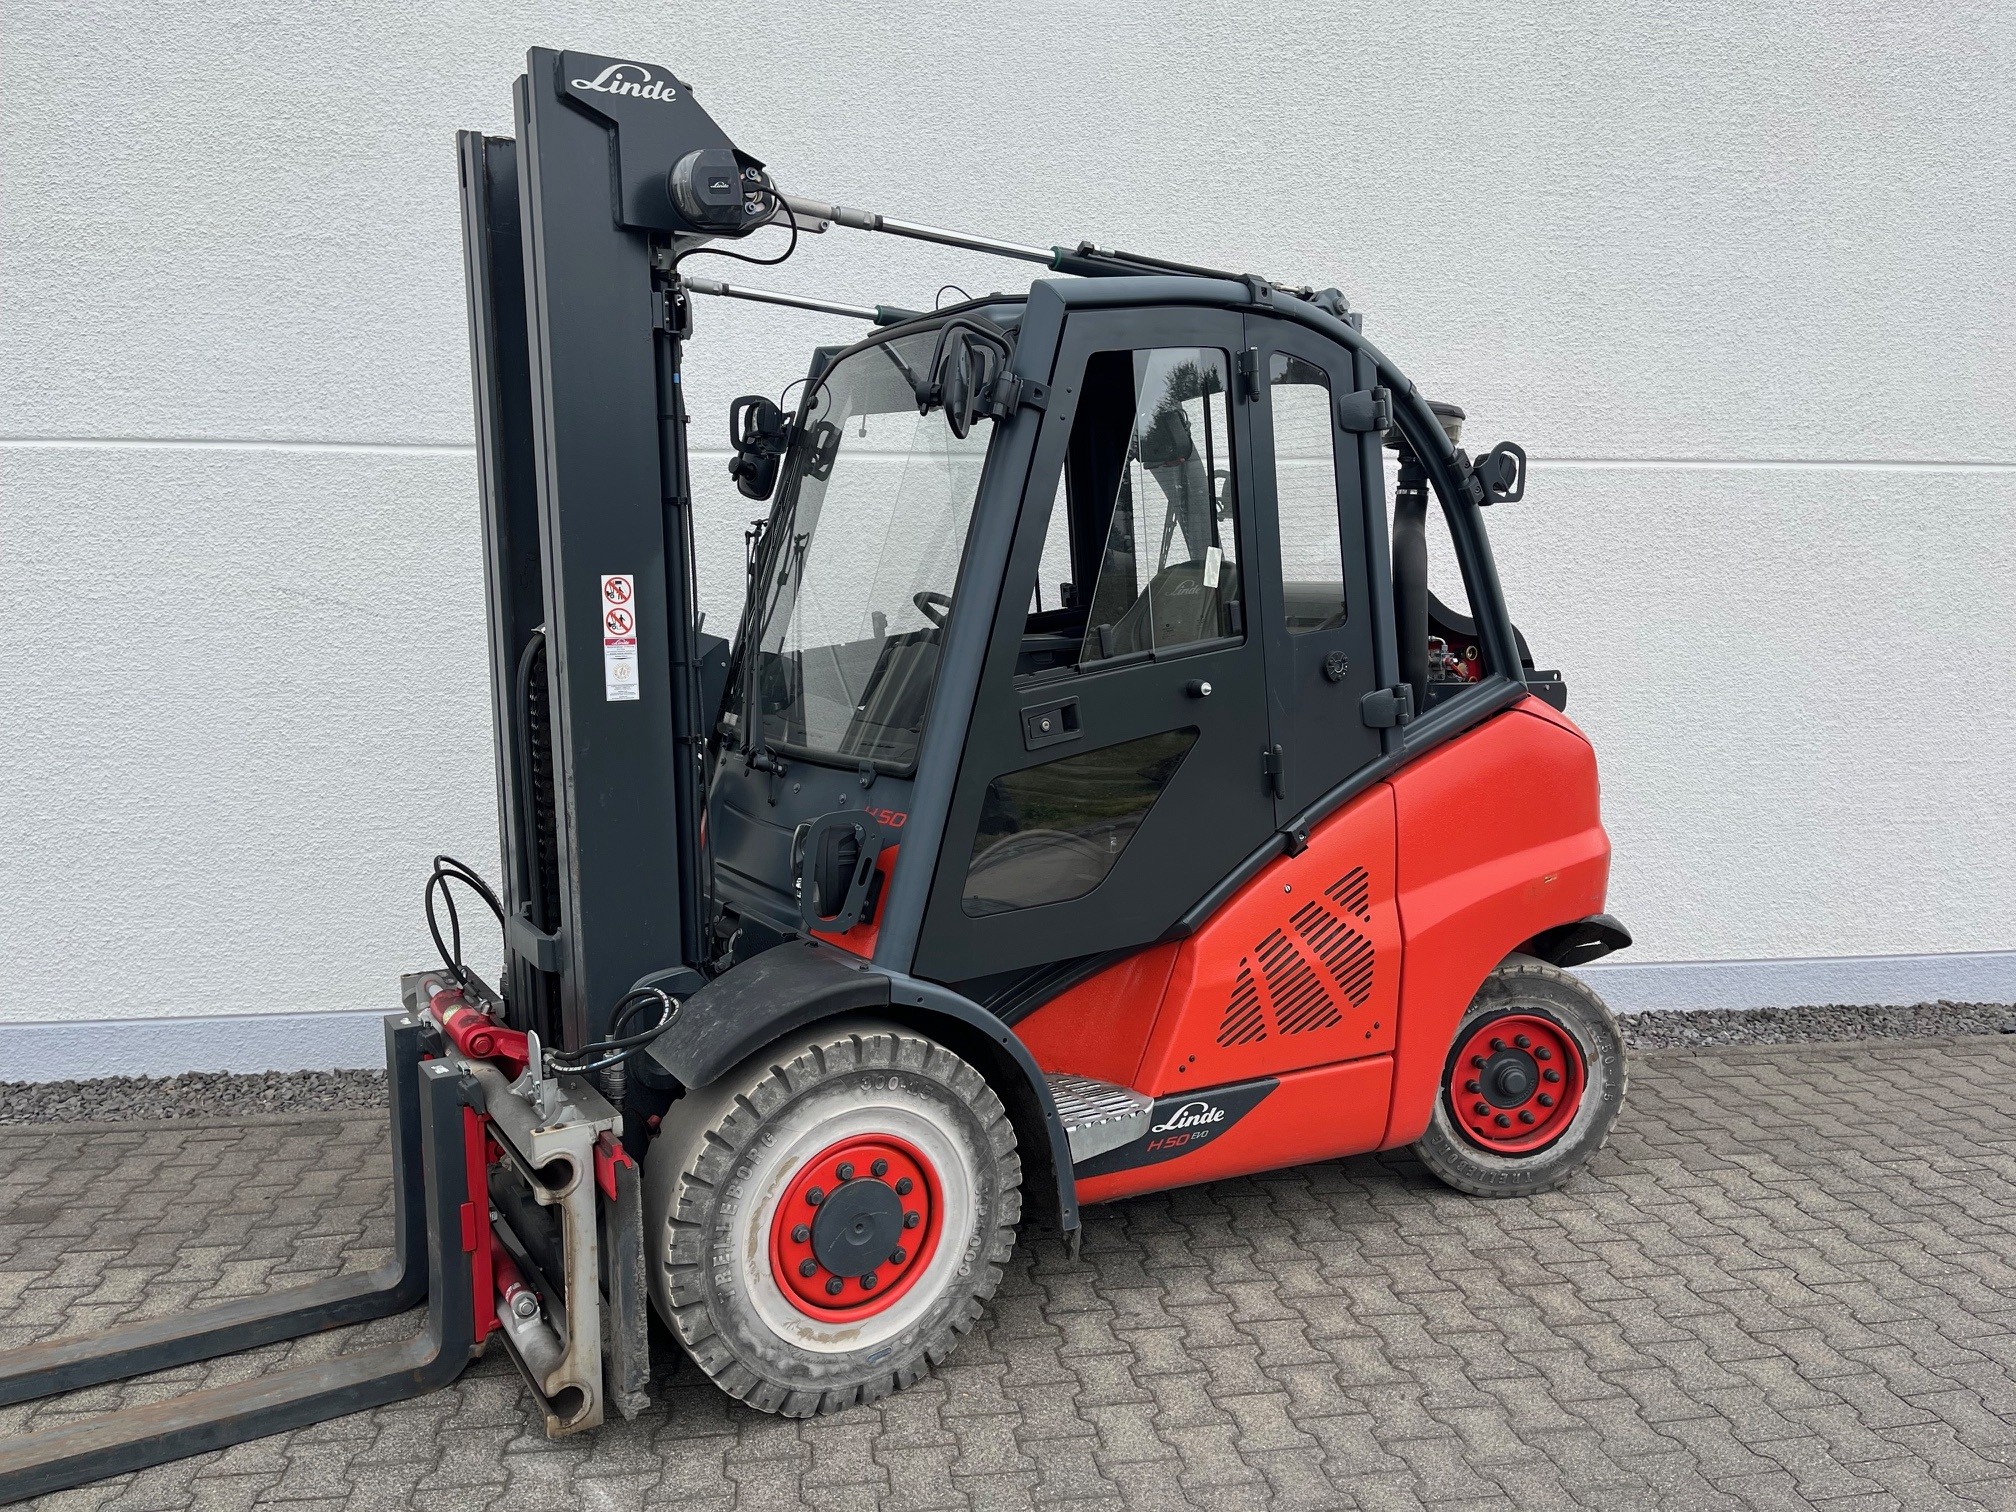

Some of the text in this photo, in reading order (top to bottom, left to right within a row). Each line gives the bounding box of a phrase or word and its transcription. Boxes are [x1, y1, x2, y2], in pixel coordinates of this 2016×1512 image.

[571, 63, 677, 103] Linde
[1165, 579, 1201, 596] Linde
[1151, 1101, 1225, 1133] Linde
[711, 1131, 779, 1305] TRELLEBORG
